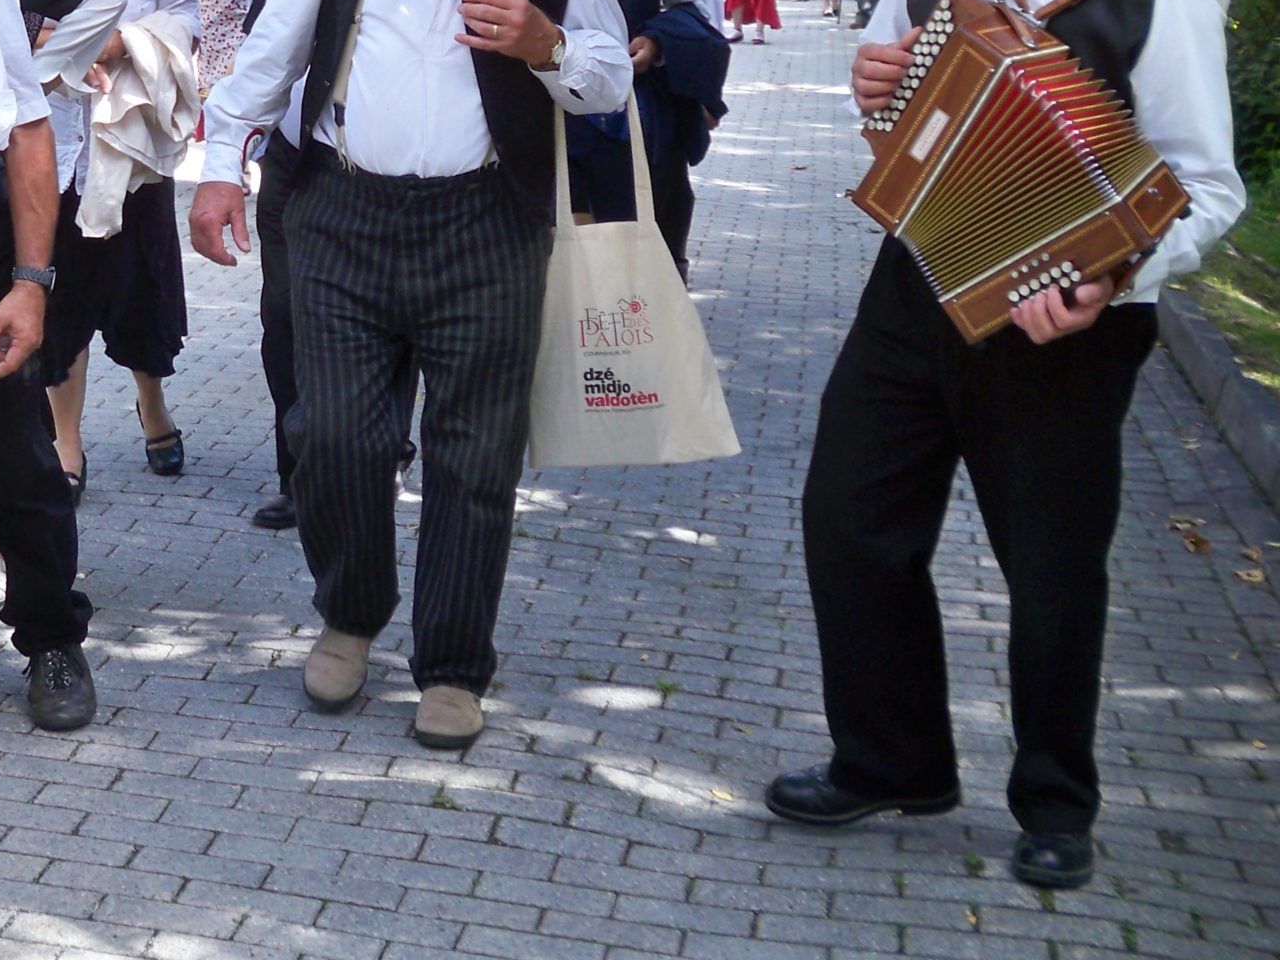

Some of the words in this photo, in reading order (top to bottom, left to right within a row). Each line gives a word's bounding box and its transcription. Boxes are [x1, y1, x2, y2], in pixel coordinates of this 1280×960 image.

[583, 367, 614, 381] dzé
[584, 380, 631, 396] midjo
[584, 390, 659, 407] valdotèn
